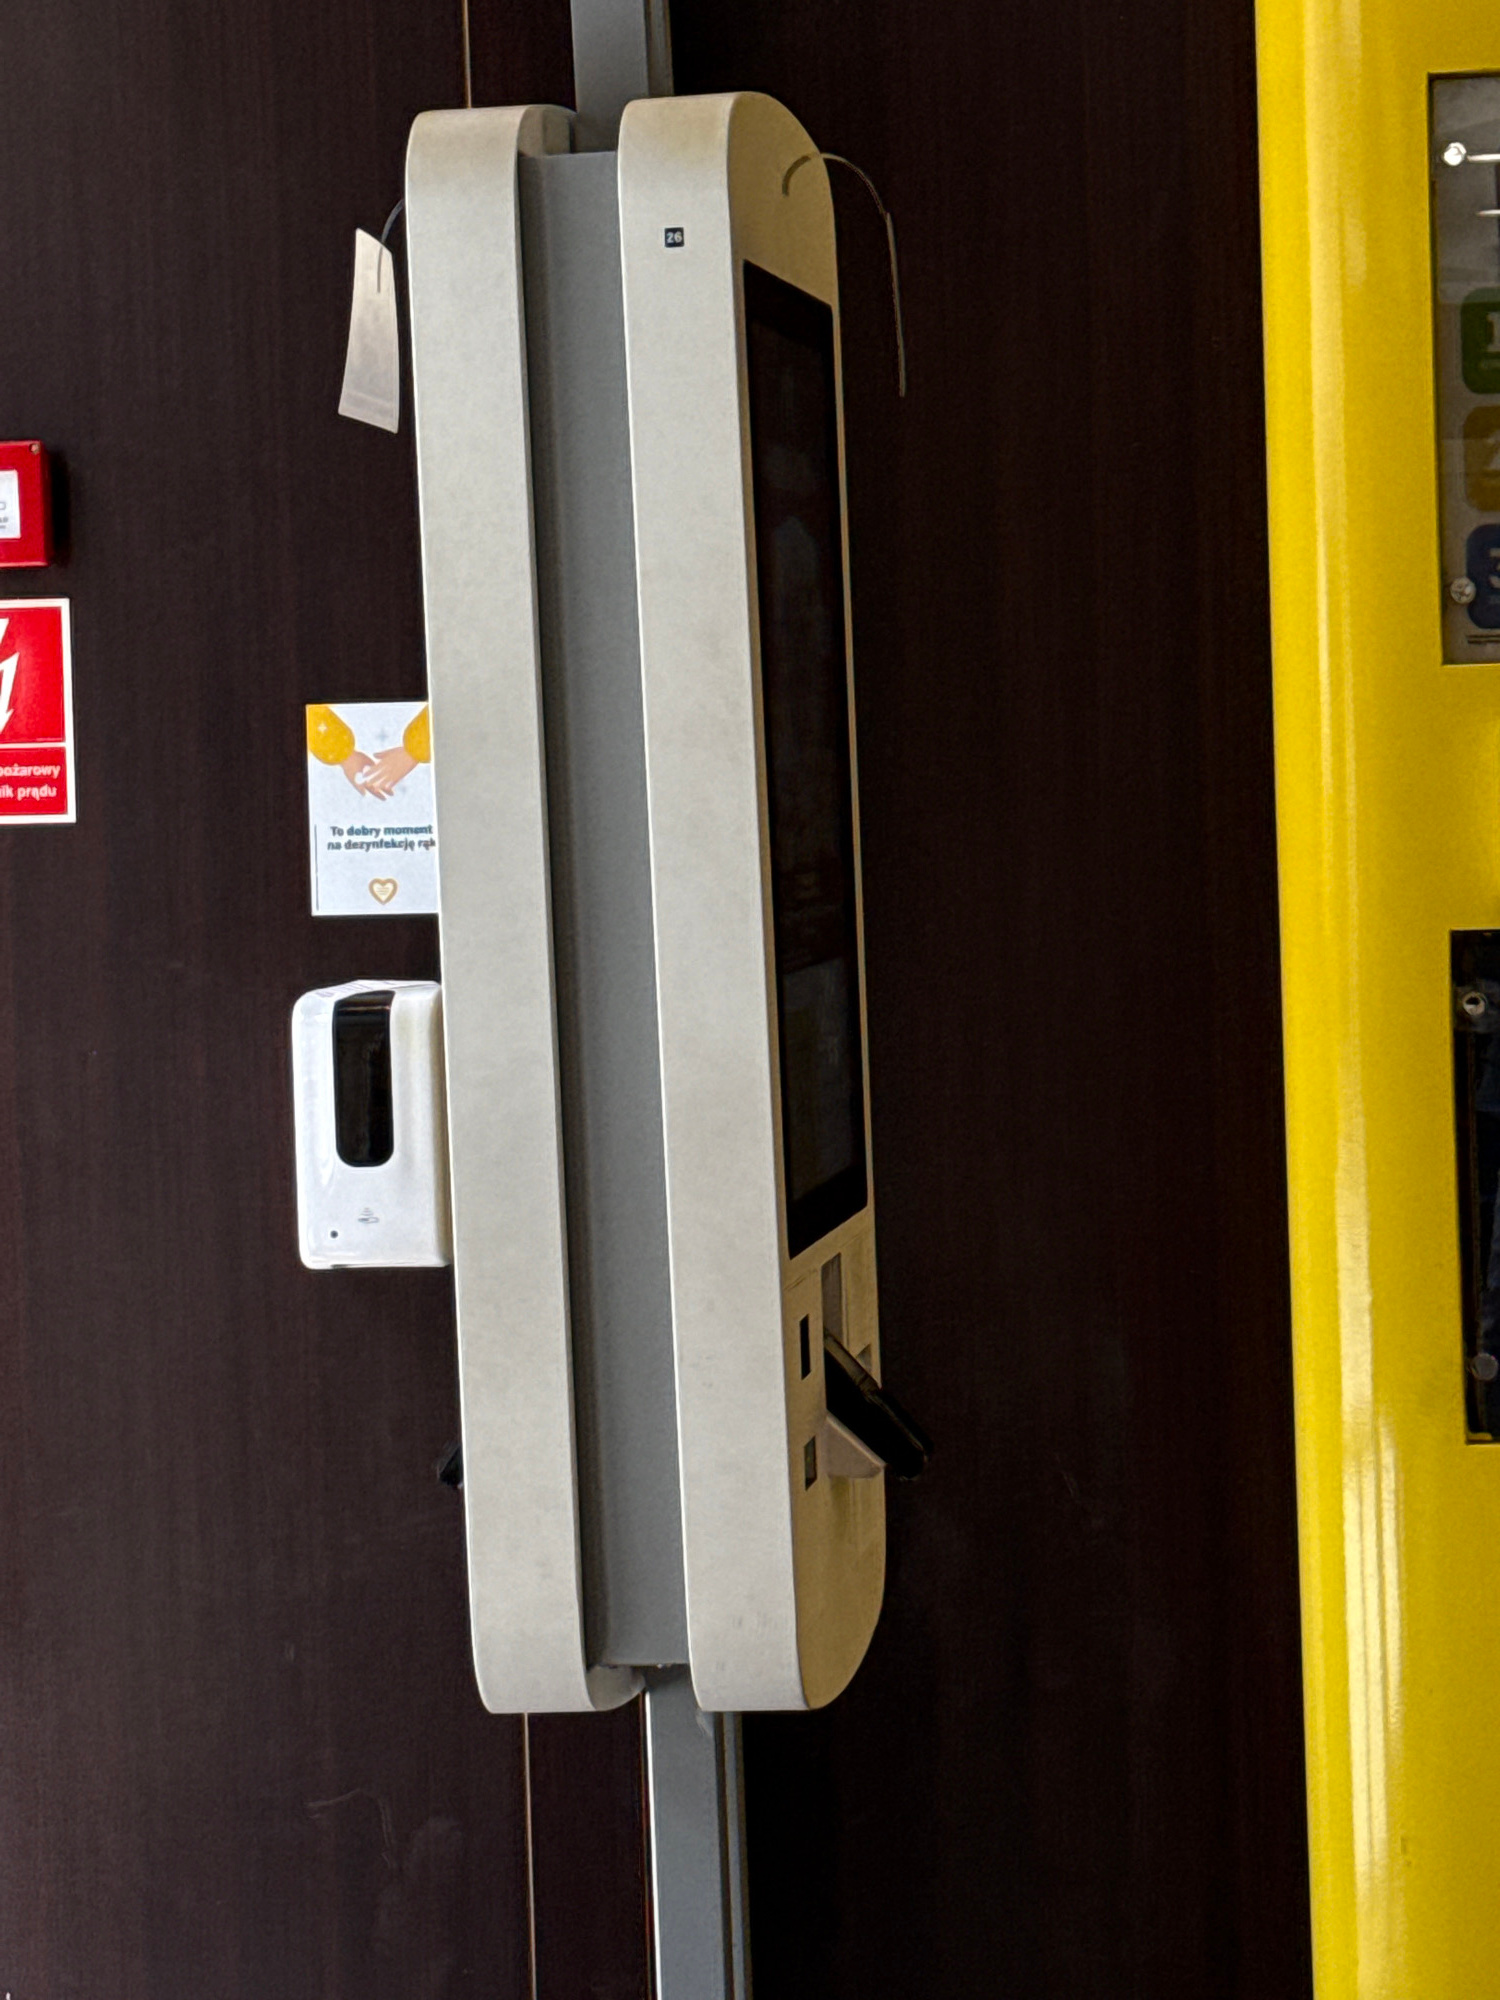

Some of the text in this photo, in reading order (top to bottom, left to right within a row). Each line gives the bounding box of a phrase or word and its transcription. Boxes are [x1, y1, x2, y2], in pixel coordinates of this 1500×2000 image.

[667, 231, 682, 243] 26
[17, 784, 57, 801] prądu
[330, 824, 433, 838] To dobry moment
[327, 841, 342, 850] na
[344, 837, 415, 852] dezynfekcję
